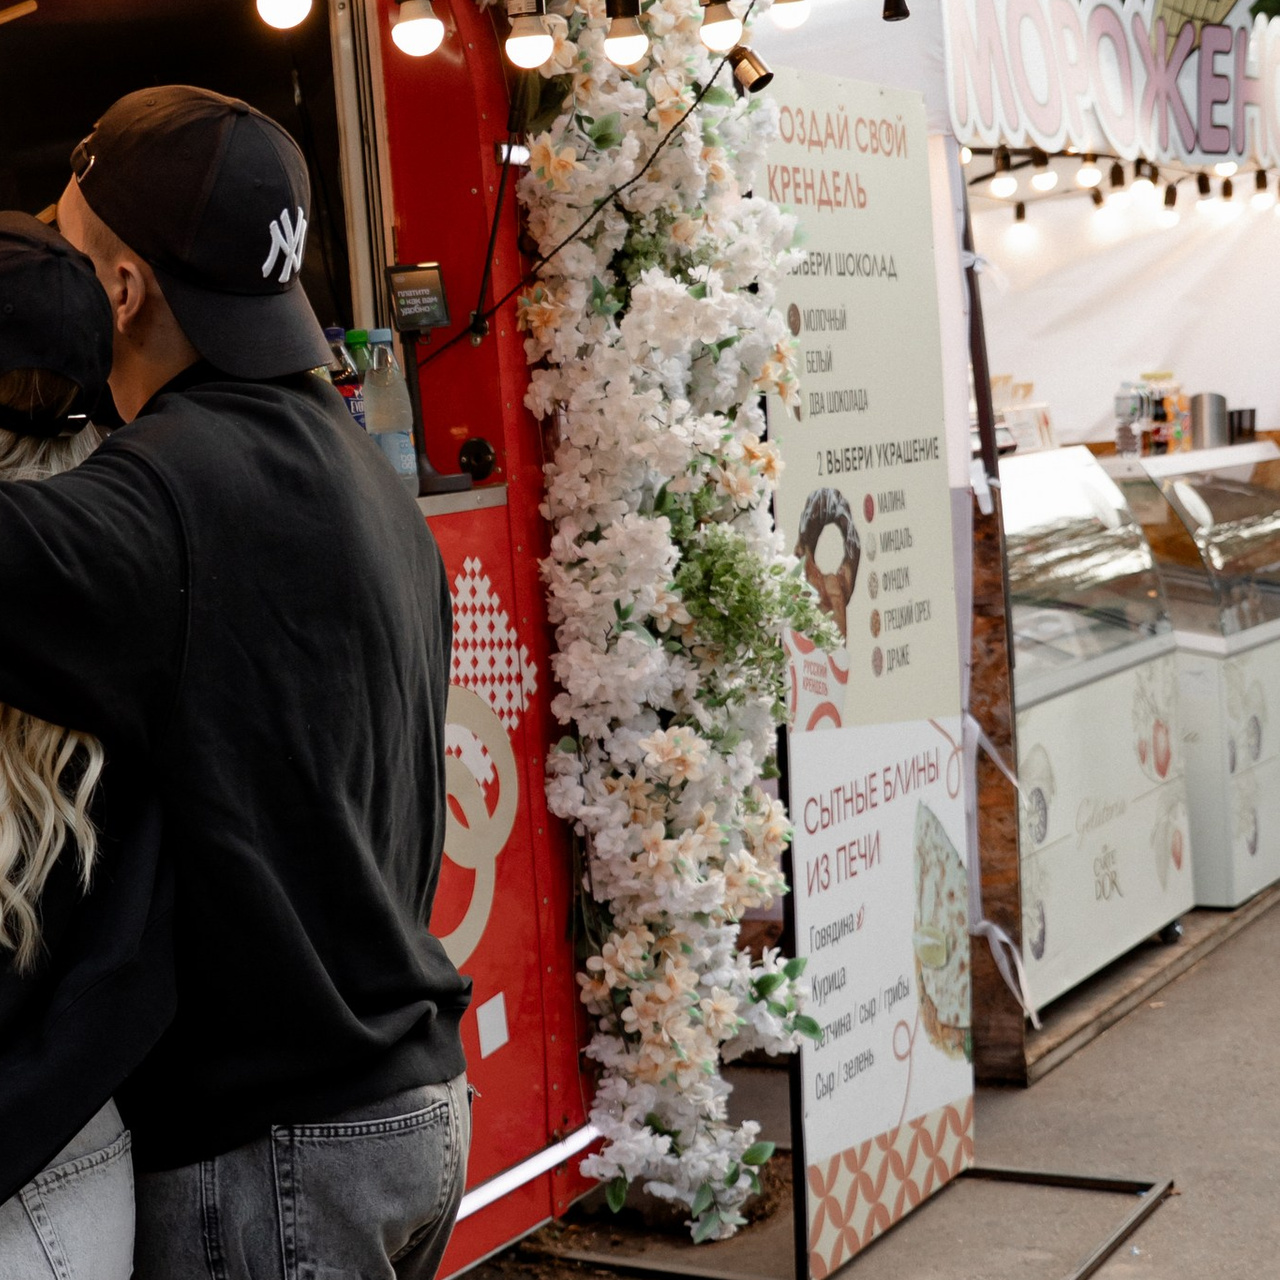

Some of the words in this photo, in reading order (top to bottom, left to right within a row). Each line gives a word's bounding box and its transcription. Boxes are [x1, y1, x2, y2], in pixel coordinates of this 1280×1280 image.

[778, 105, 851, 156] ОЗДАЙ
[854, 114, 908, 159] СВОЙ
[767, 164, 868, 214] КРЕНДЕЛЬ
[787, 252, 832, 277] ЫБЕРИ
[835, 252, 898, 281] ШОКОЛАД
[802, 304, 847, 333] МОЛОЧНЫЙ
[806, 345, 833, 374] БЕЛЫЙ
[808, 392, 825, 417] ДВА
[826, 389, 869, 414] ШОКОЛАДА
[826, 444, 874, 475] ВЫБЕРИ
[875, 436, 940, 468] УКРАШЕНИЕ
[877, 489, 906, 515] МАЛИНА
[879, 527, 913, 554] МИНДАЛЬ
[881, 567, 910, 594] ФУНДУК
[884, 600, 914, 632] ГРЕЦКИЙ
[914, 599, 931, 622] ОРЕХ
[886, 643, 910, 674] ДРАЖЕ
[804, 772, 878, 836] СЫТНЫЕ
[882, 746, 939, 803] БЛИНЫ
[806, 853, 831, 898] ИЗ
[836, 829, 880, 884] ПЕЧИ
[809, 912, 855, 954] Говядина
[811, 966, 846, 1008] Курица
[859, 996, 876, 1025] сыр
[883, 974, 910, 1014] грибы
[815, 1070, 835, 1100] Сыр
[842, 1047, 874, 1083] зелень
